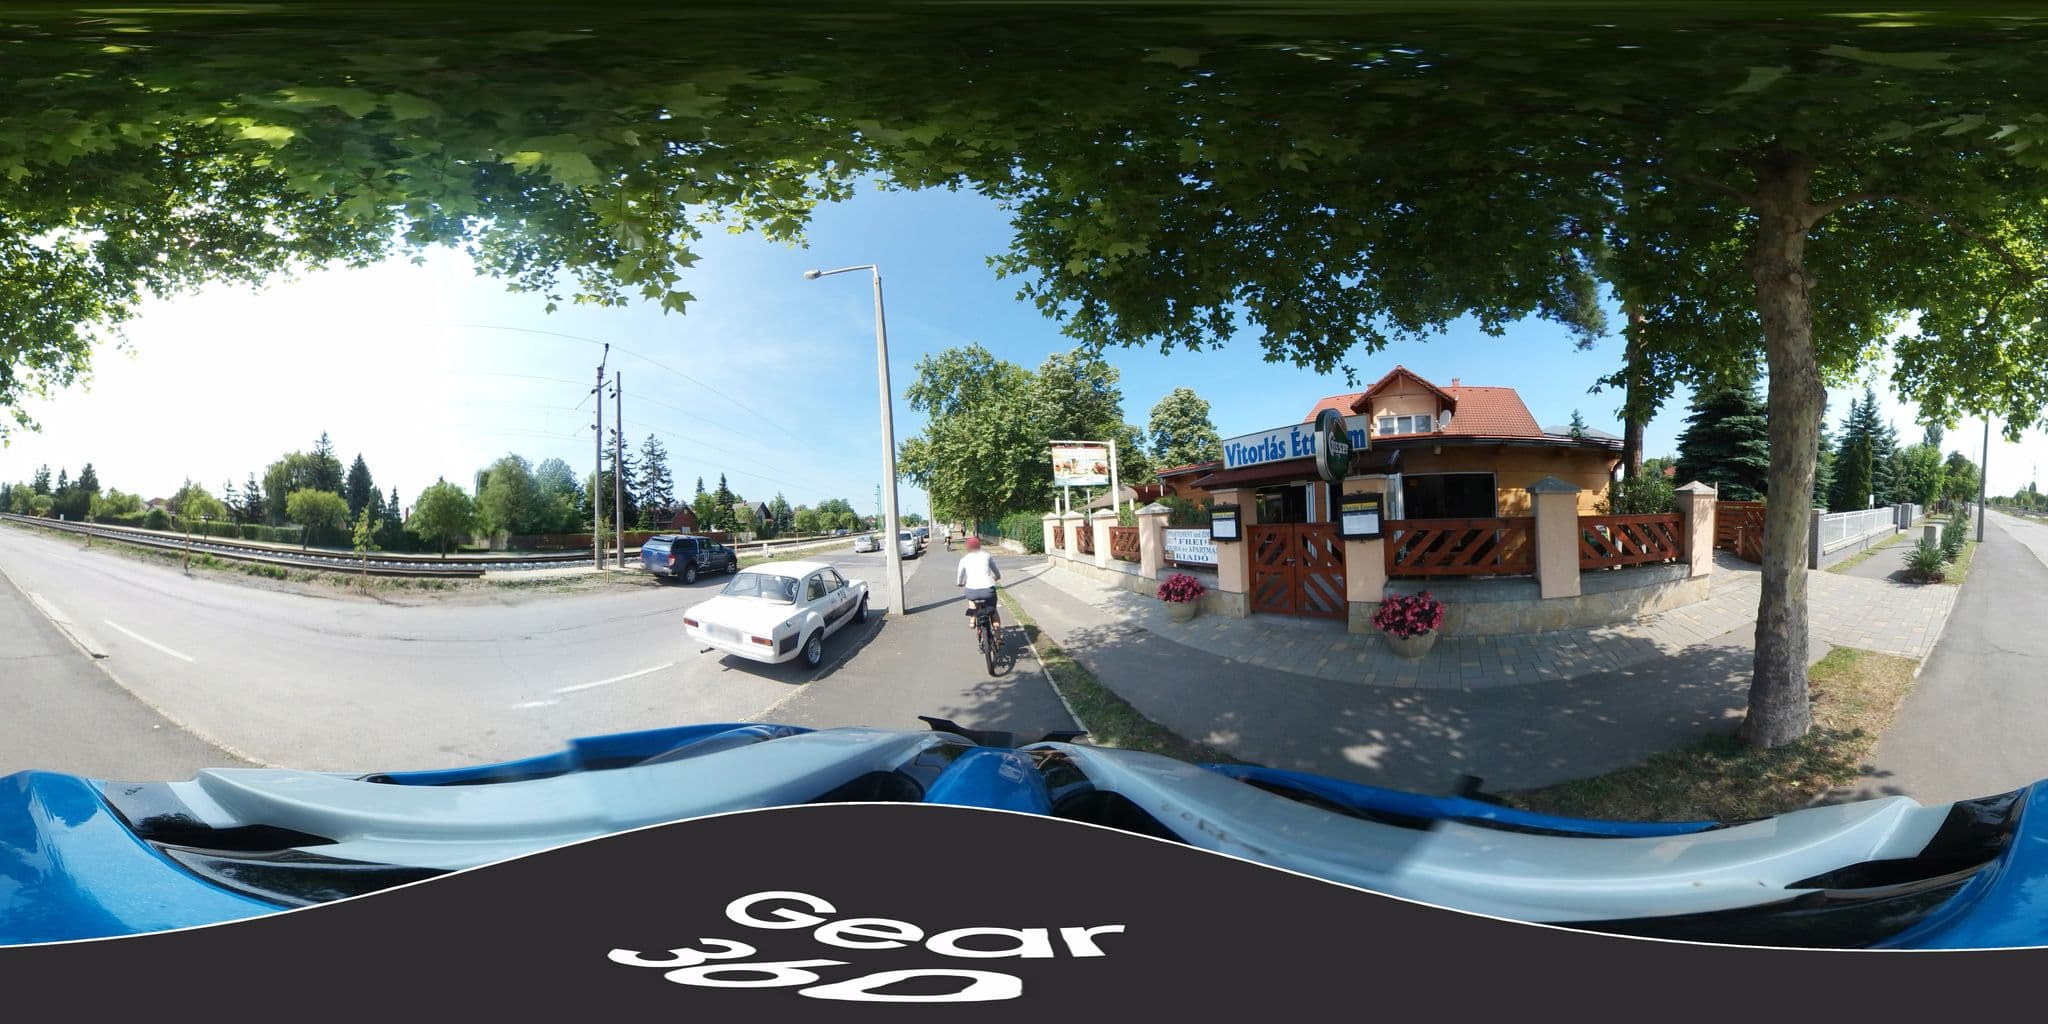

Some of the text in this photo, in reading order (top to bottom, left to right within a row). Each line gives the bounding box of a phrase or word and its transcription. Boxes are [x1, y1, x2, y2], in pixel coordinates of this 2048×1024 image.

[1225, 427, 1366, 467] Vitorlás Éttm
[1179, 538, 1203, 546] FREI
